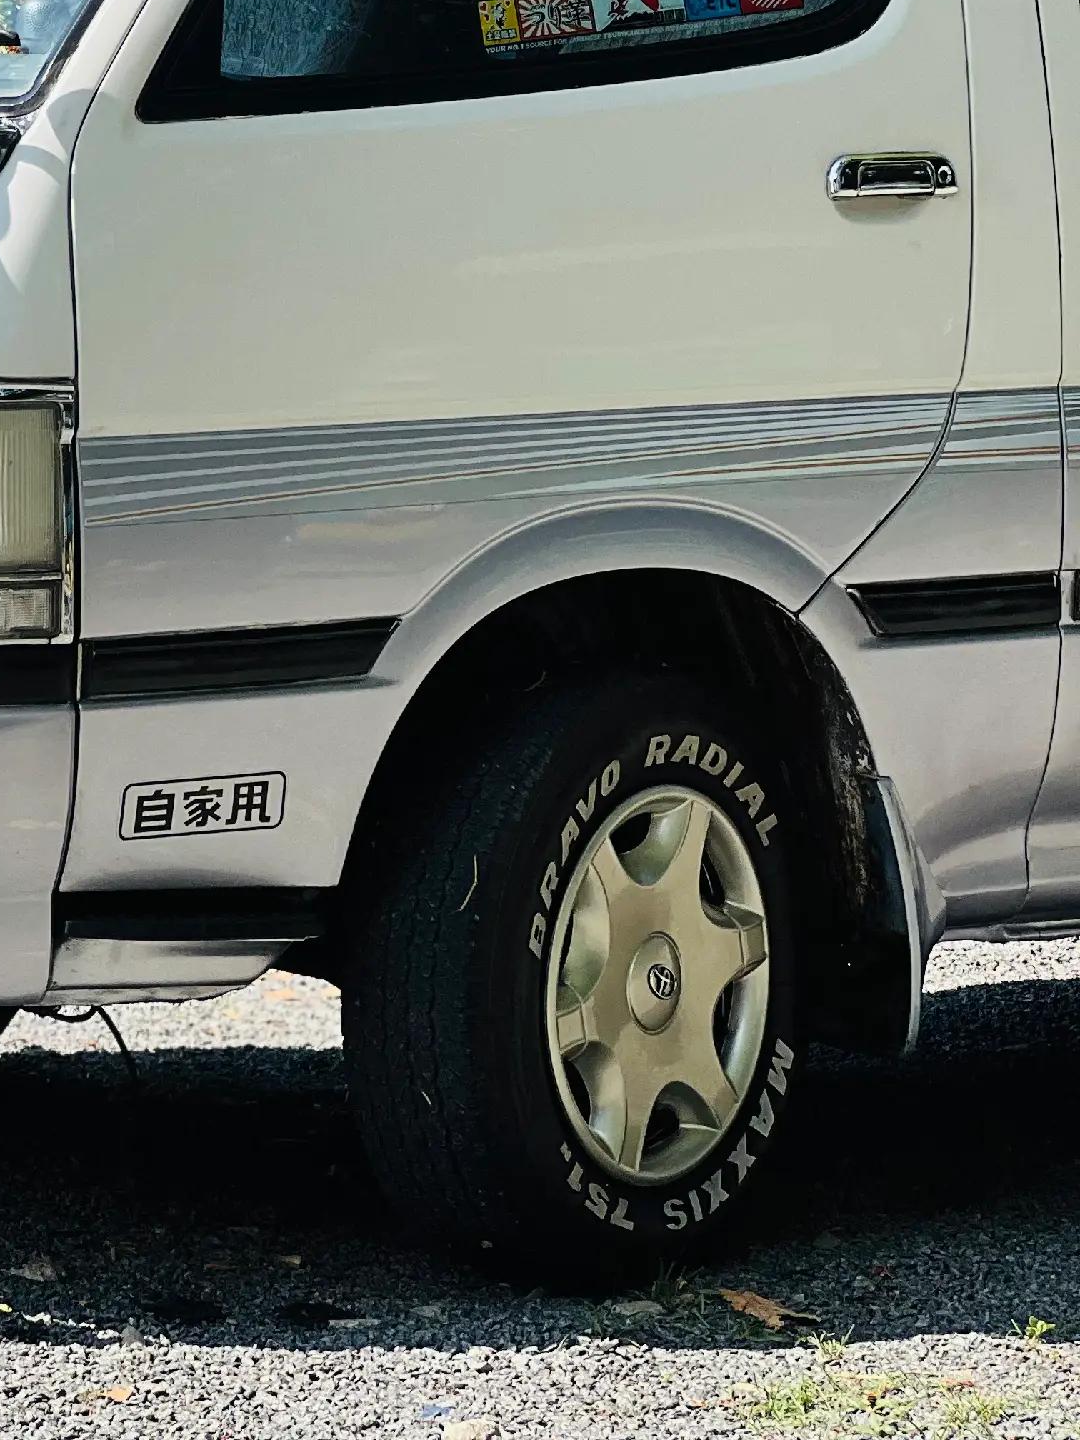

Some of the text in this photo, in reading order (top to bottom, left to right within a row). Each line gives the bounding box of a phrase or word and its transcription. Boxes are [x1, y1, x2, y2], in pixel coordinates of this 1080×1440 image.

[486, 45, 506, 54] YOUR
[525, 40, 552, 49] SOURCE
[134, 780, 271, 833] 自家用
[528, 734, 782, 960] BRAVO RADIAL
[663, 1038, 794, 1231] MAXXIS
